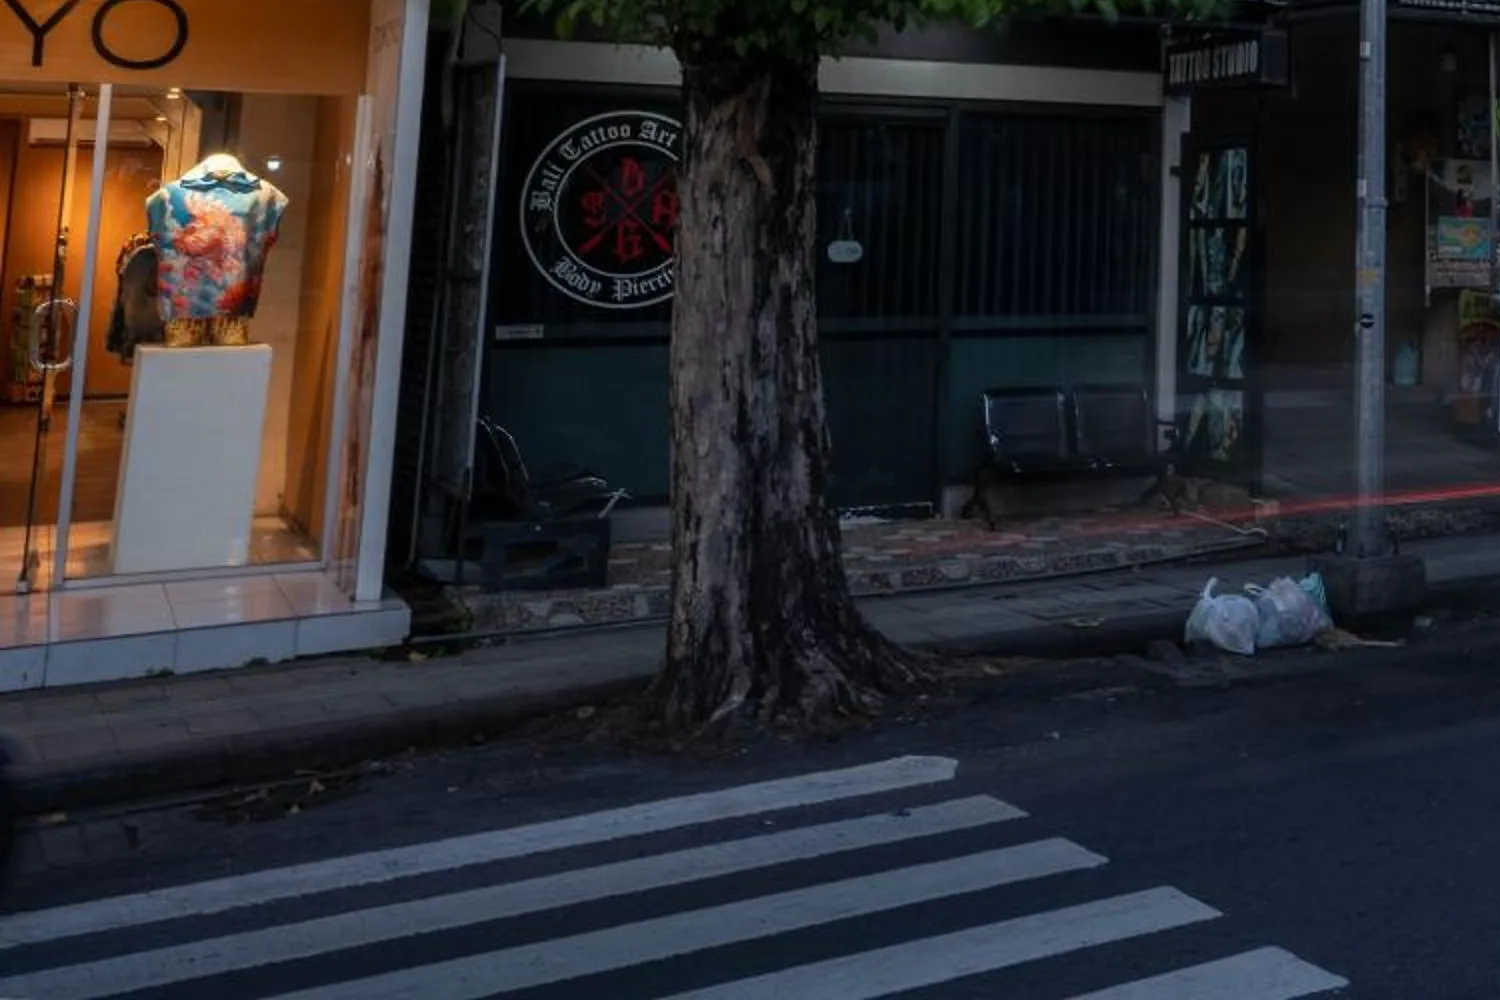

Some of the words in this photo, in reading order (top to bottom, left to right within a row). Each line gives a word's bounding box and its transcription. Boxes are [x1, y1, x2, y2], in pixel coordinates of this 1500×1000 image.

[528, 161, 565, 212] Bali
[559, 122, 632, 161] Tattoo
[638, 119, 679, 149] Art
[551, 255, 602, 300] Body
